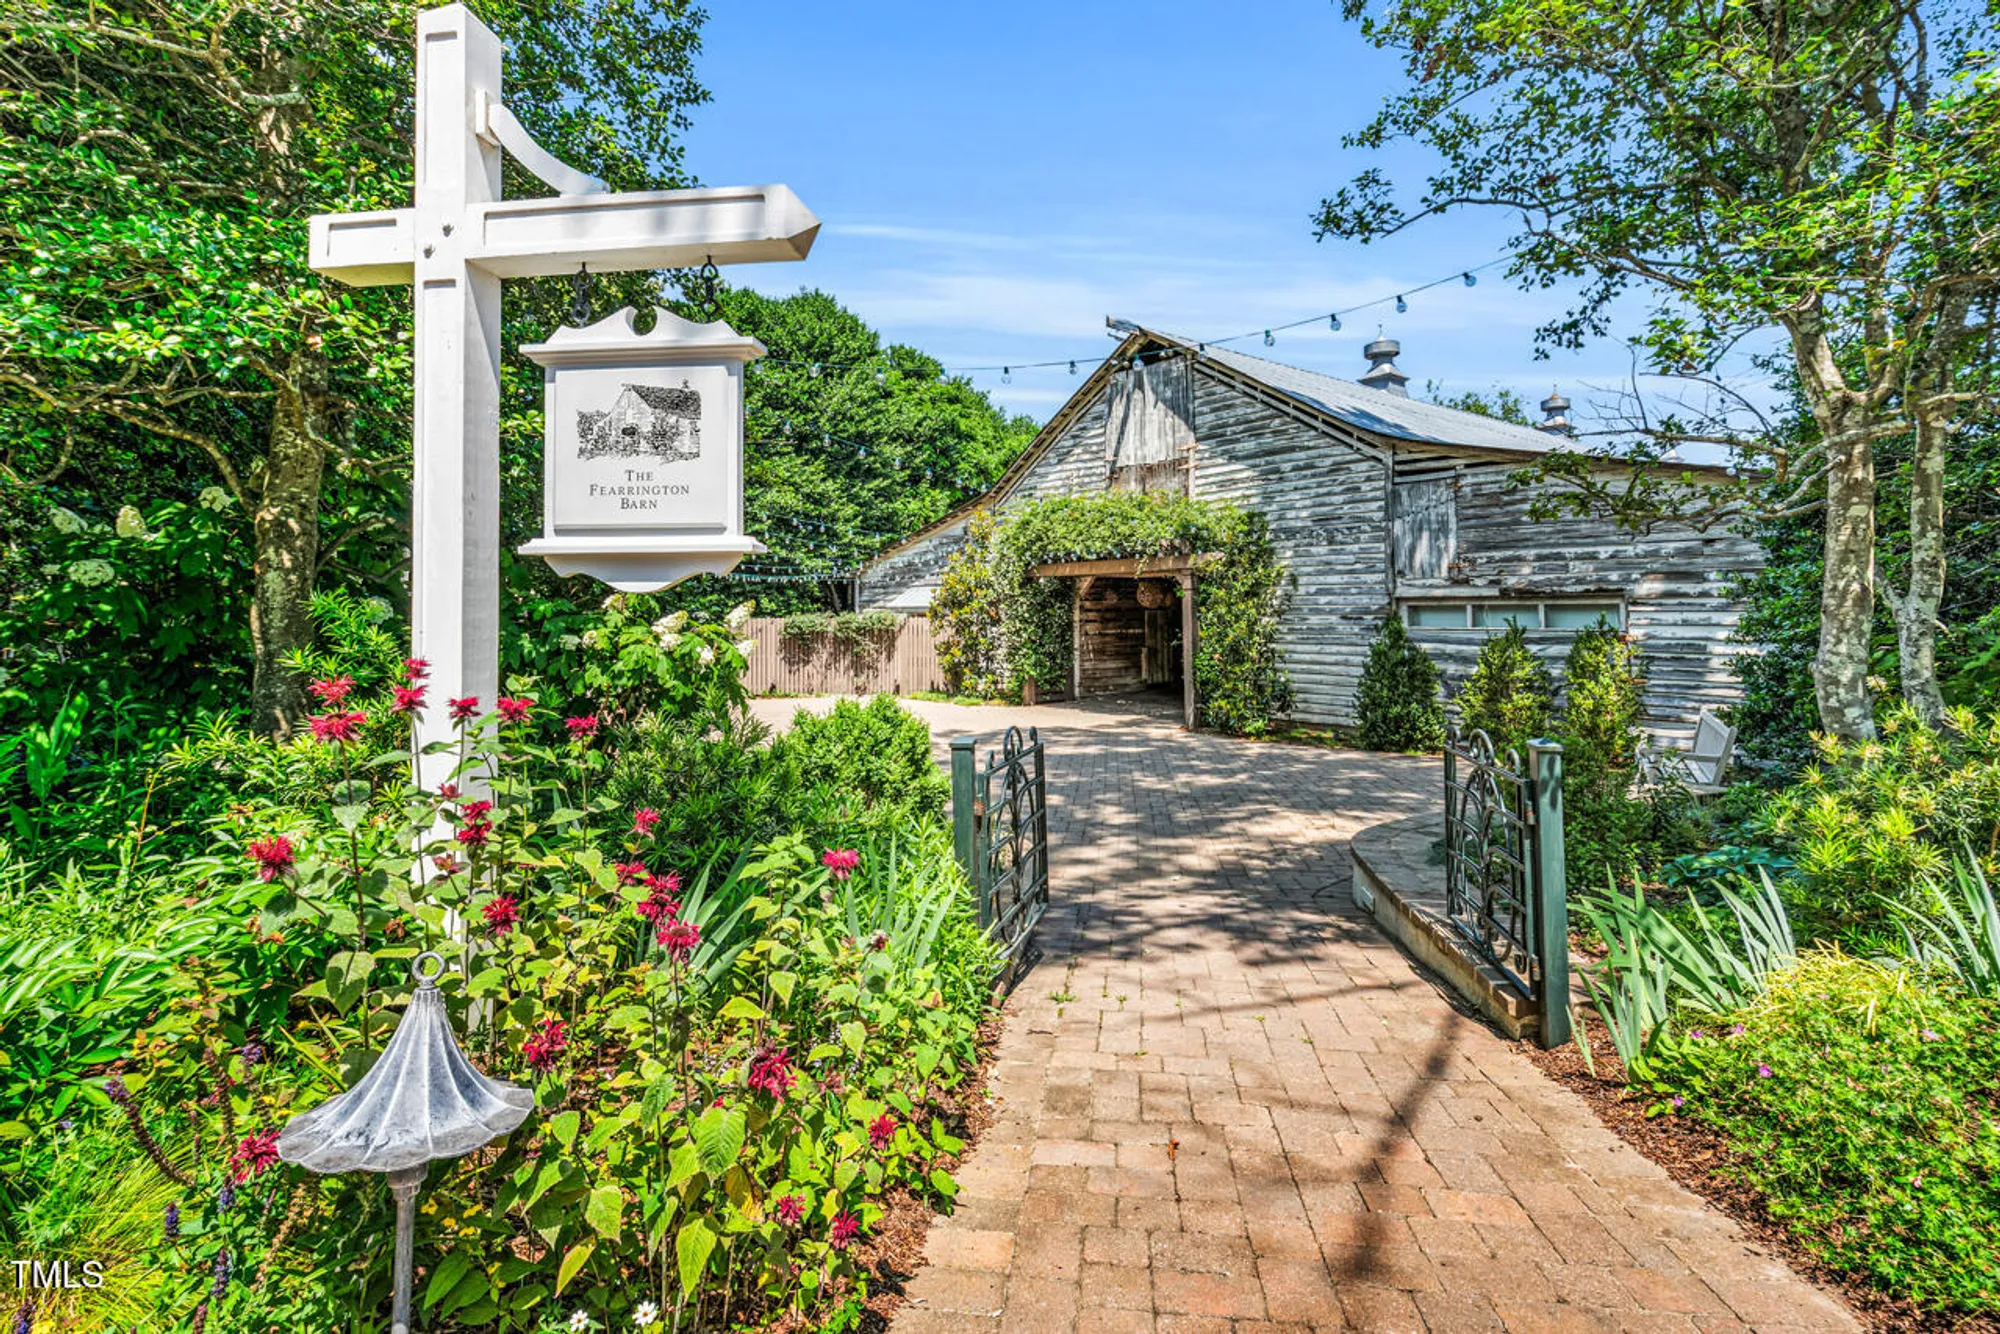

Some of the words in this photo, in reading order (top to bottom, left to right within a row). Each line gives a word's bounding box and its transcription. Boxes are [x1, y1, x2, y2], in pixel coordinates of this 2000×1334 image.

[624, 469, 653, 482] THE
[589, 484, 690, 496] FEARRINGTON
[620, 497, 658, 510] BARN
